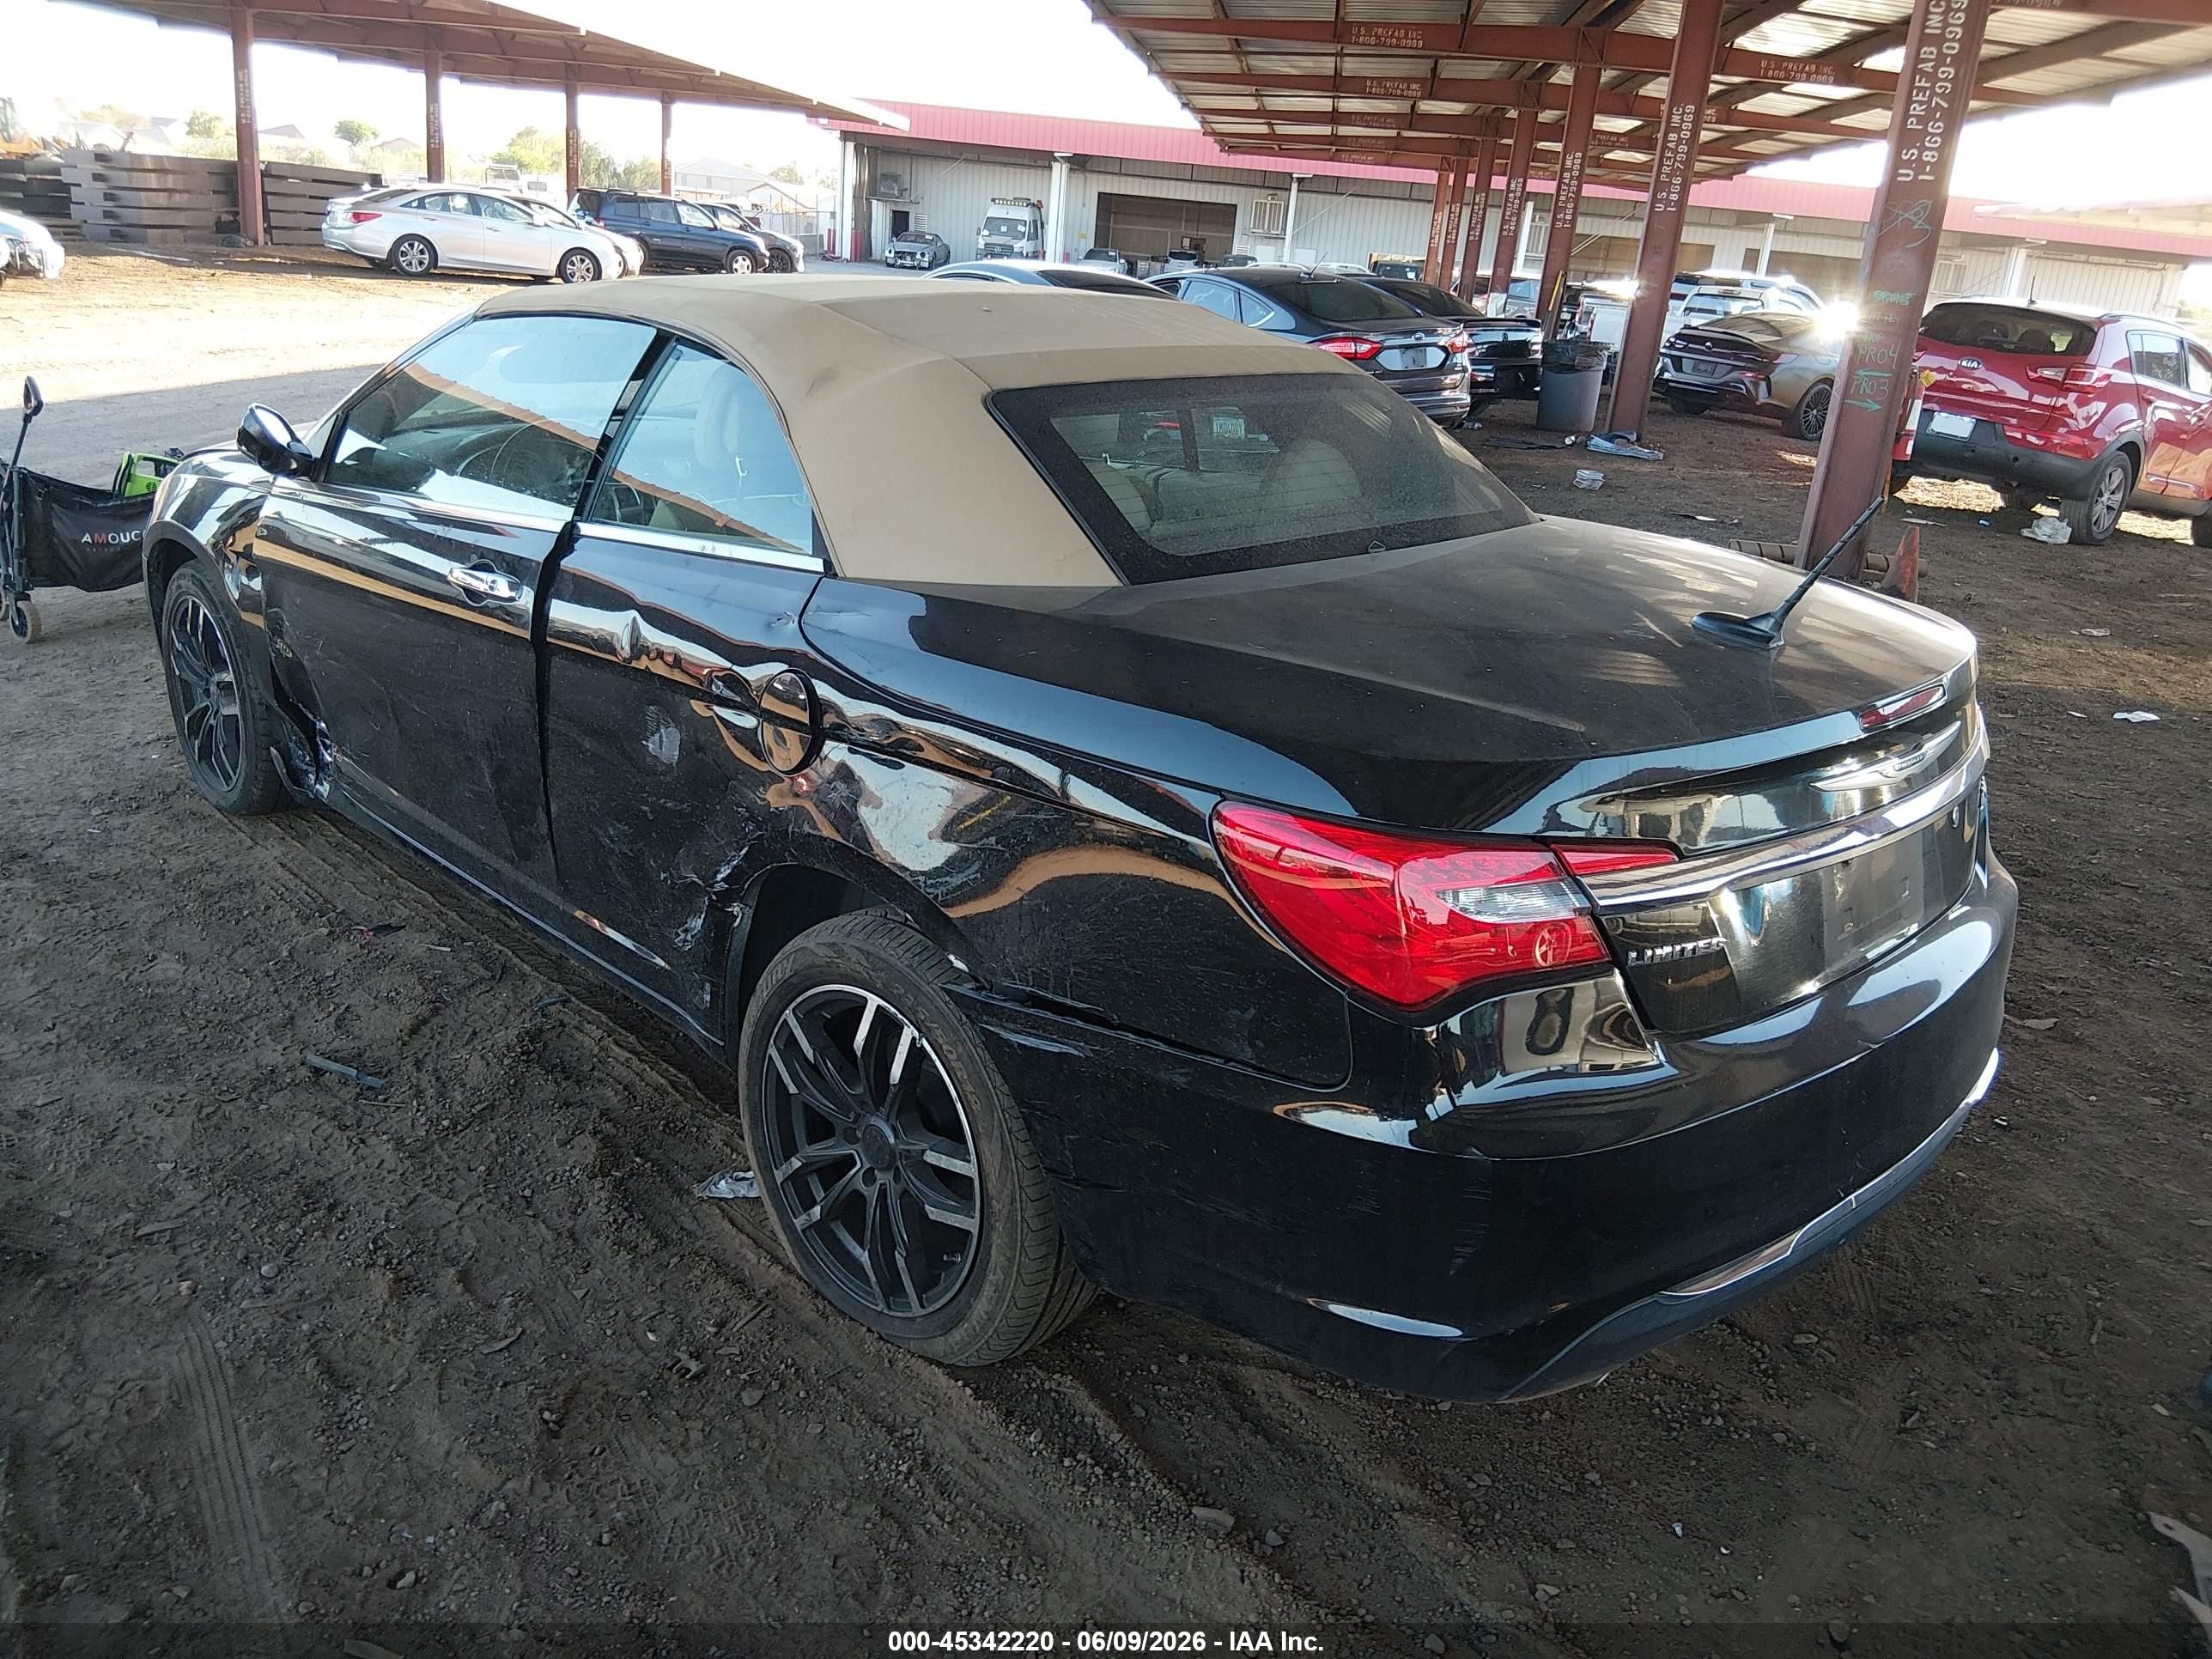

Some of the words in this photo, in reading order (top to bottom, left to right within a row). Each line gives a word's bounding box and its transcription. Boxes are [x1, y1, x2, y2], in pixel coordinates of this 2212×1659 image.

[1372, 27, 1405, 38] PREFAB
[1782, 61, 1816, 72] PREFAB
[1382, 81, 1407, 89] PREFAB
[1907, 46, 1937, 129] PREFAB
[1918, 0, 1969, 180] 1-866-799-0969
[1670, 103, 1685, 127] INC.
[1660, 133, 1678, 181] PREFAB
[1666, 105, 1695, 211] 1-866-799-0969
[1897, 142, 1920, 181] U.S.
[1559, 172, 1571, 206] PREFAB
[1654, 188, 1668, 211] U.S.
[1504, 193, 1514, 220] PREFAB
[1555, 211, 1565, 228] U.S.
[1961, 358, 1978, 368] KIA
[81, 531, 146, 544] AMOUC
